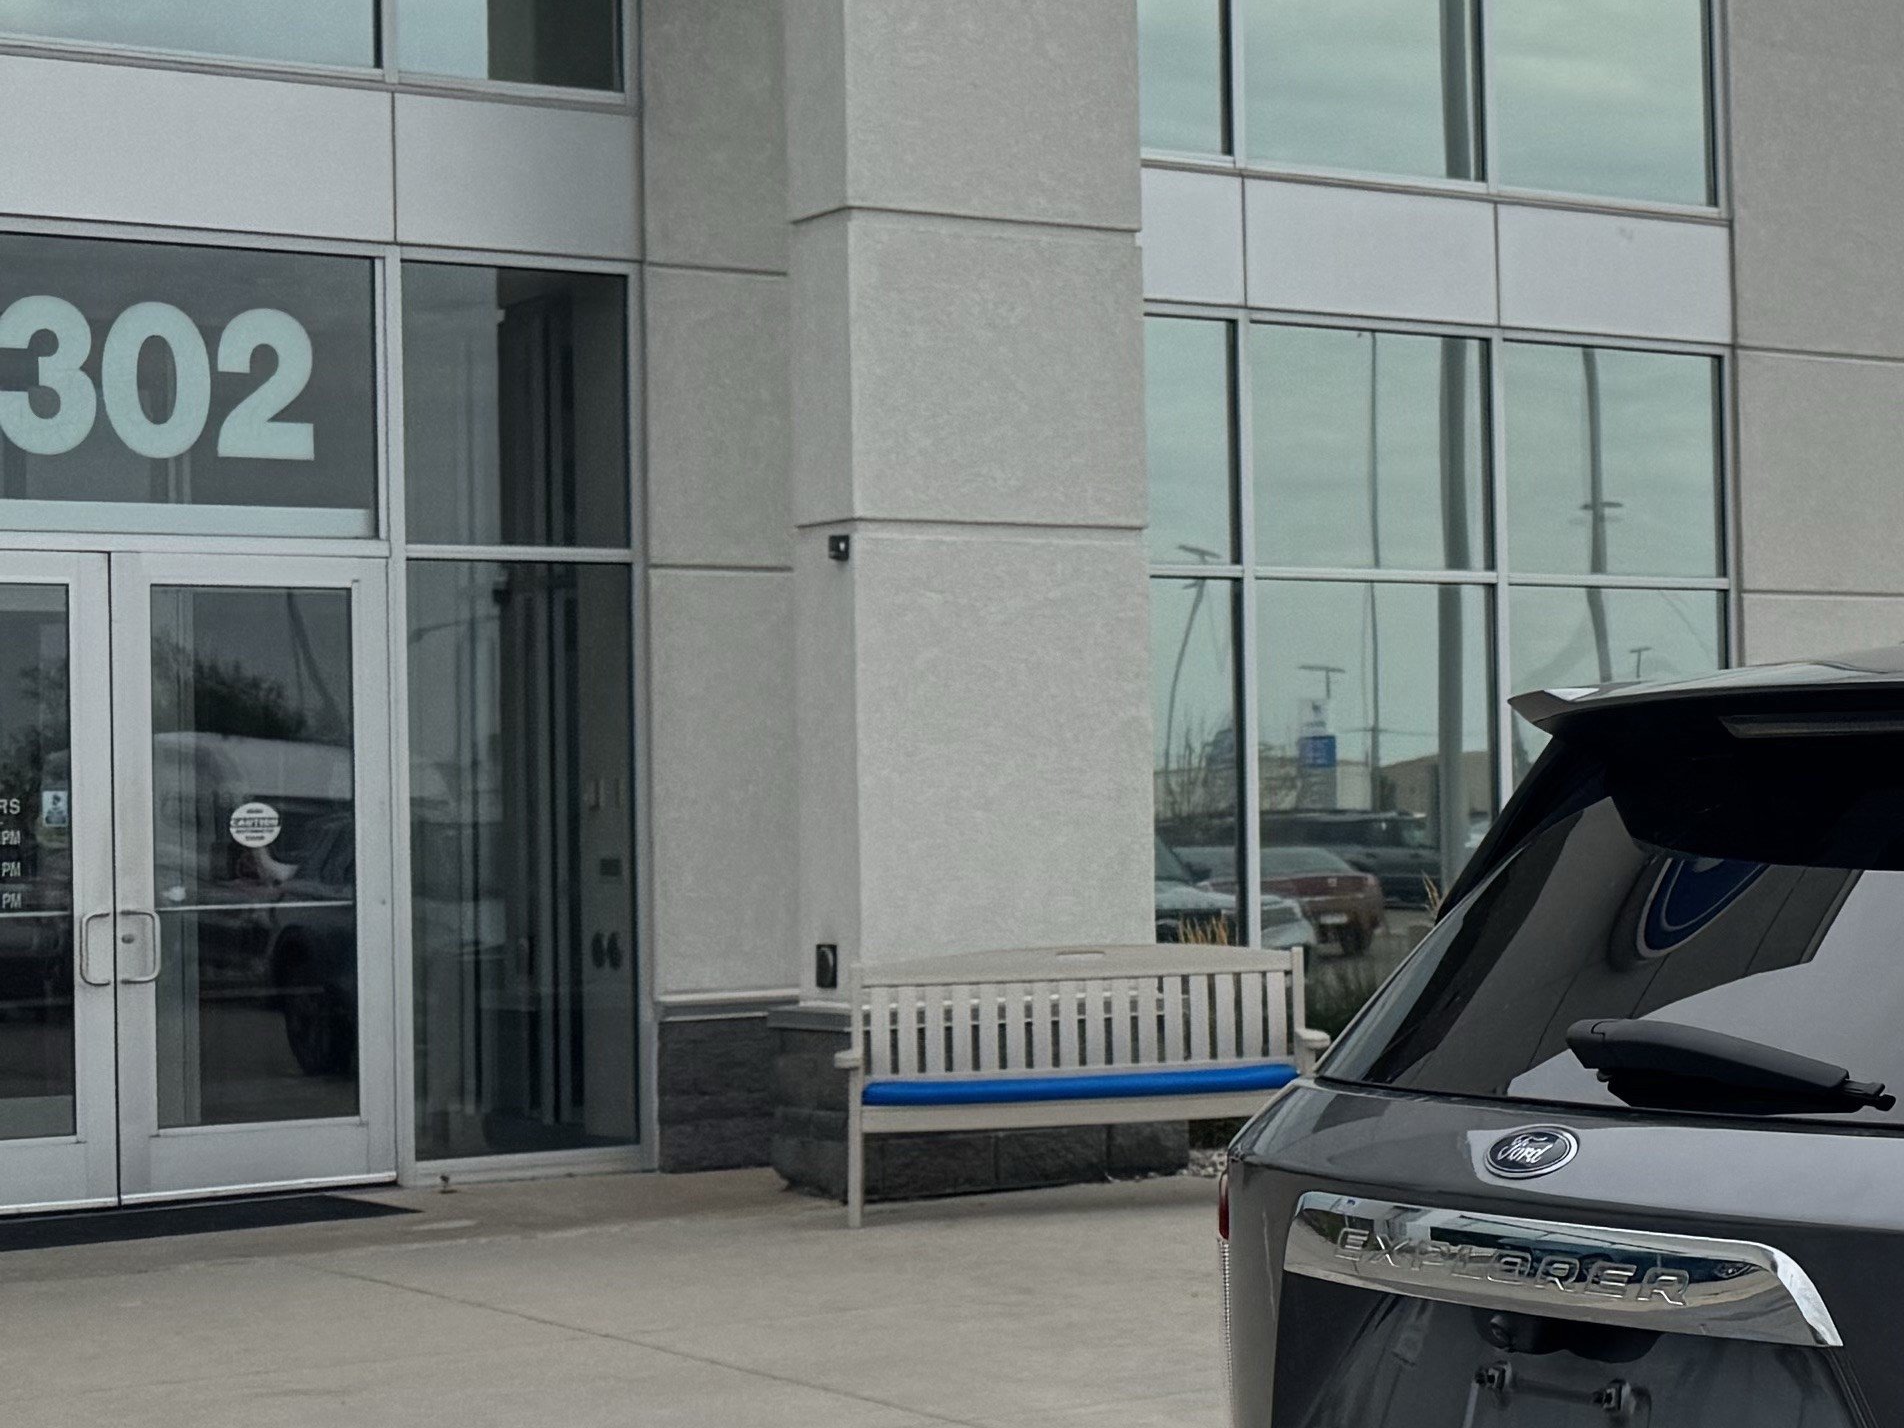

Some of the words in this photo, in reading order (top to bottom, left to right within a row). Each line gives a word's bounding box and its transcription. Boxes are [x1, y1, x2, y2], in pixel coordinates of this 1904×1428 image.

[0, 294, 315, 461] 302
[2, 830, 20, 845] PM
[2, 861, 20, 877] PM
[2, 892, 21, 909] PM
[1497, 1134, 1554, 1164] Ford
[1334, 1226, 1692, 1309] EXPLORER
